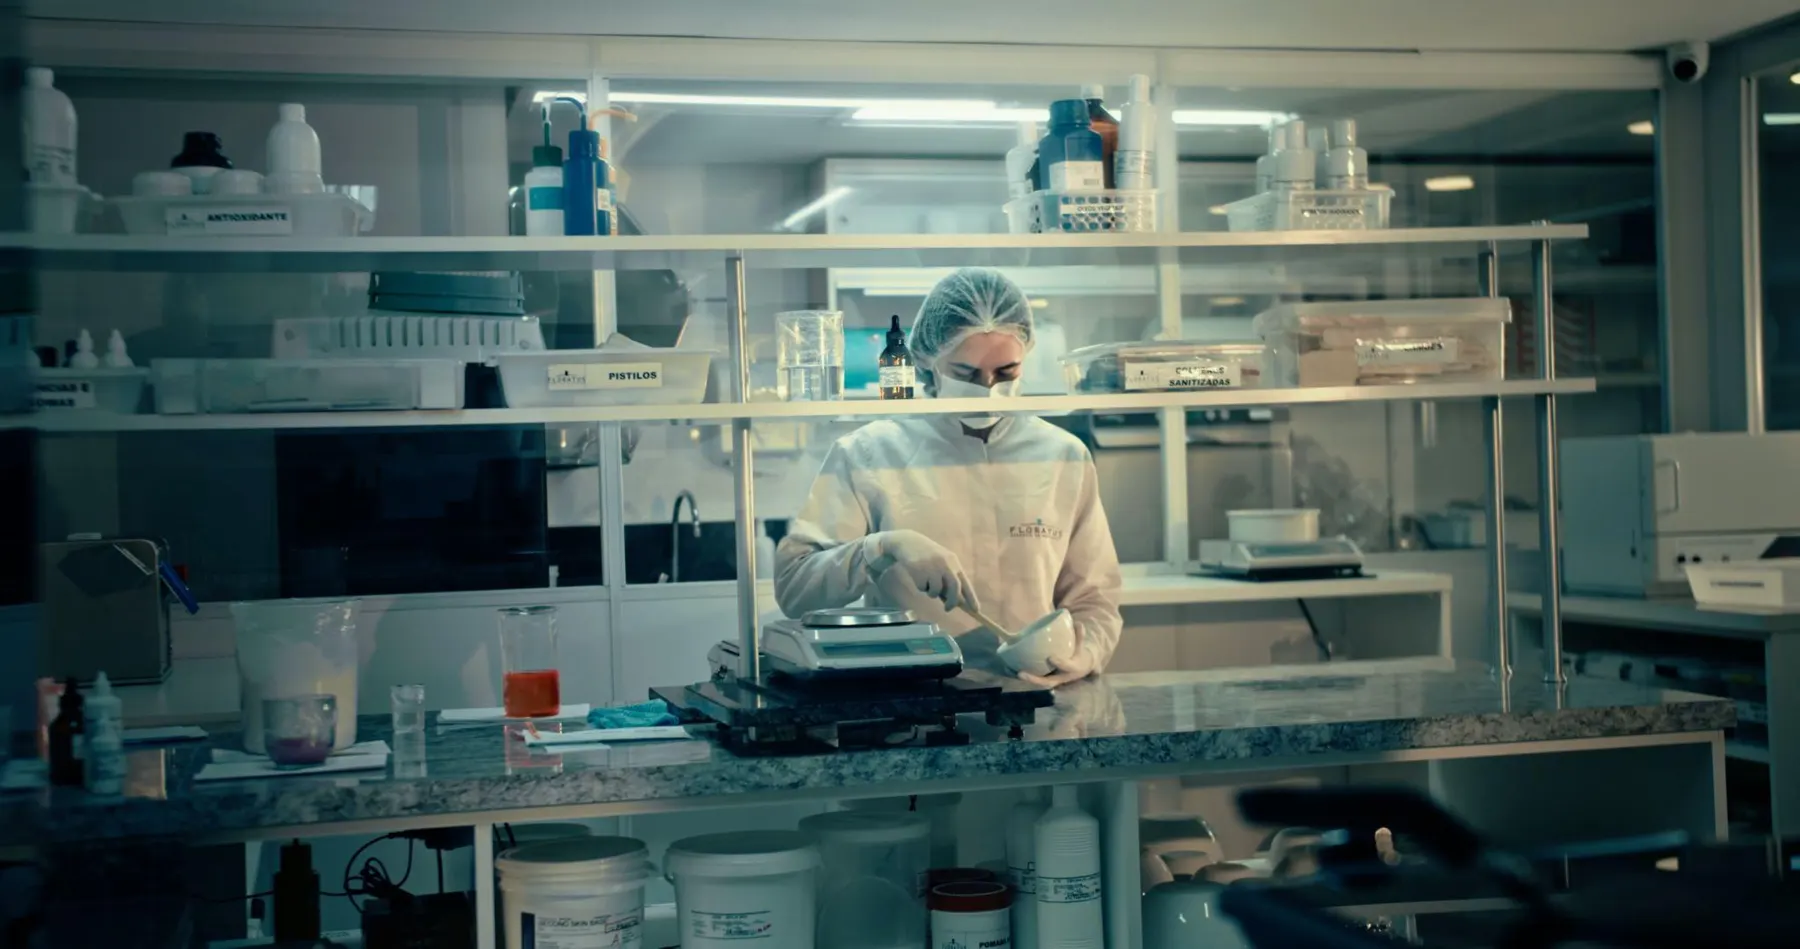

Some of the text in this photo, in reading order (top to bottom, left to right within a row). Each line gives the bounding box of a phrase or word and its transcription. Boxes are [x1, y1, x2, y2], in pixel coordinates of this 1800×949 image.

[207, 212, 288, 222] ANTIOXIDANTE
[608, 371, 657, 381] PISTILOS
[1169, 379, 1231, 388] SANITIZADAS
[1009, 526, 1063, 538] FLORATUS
